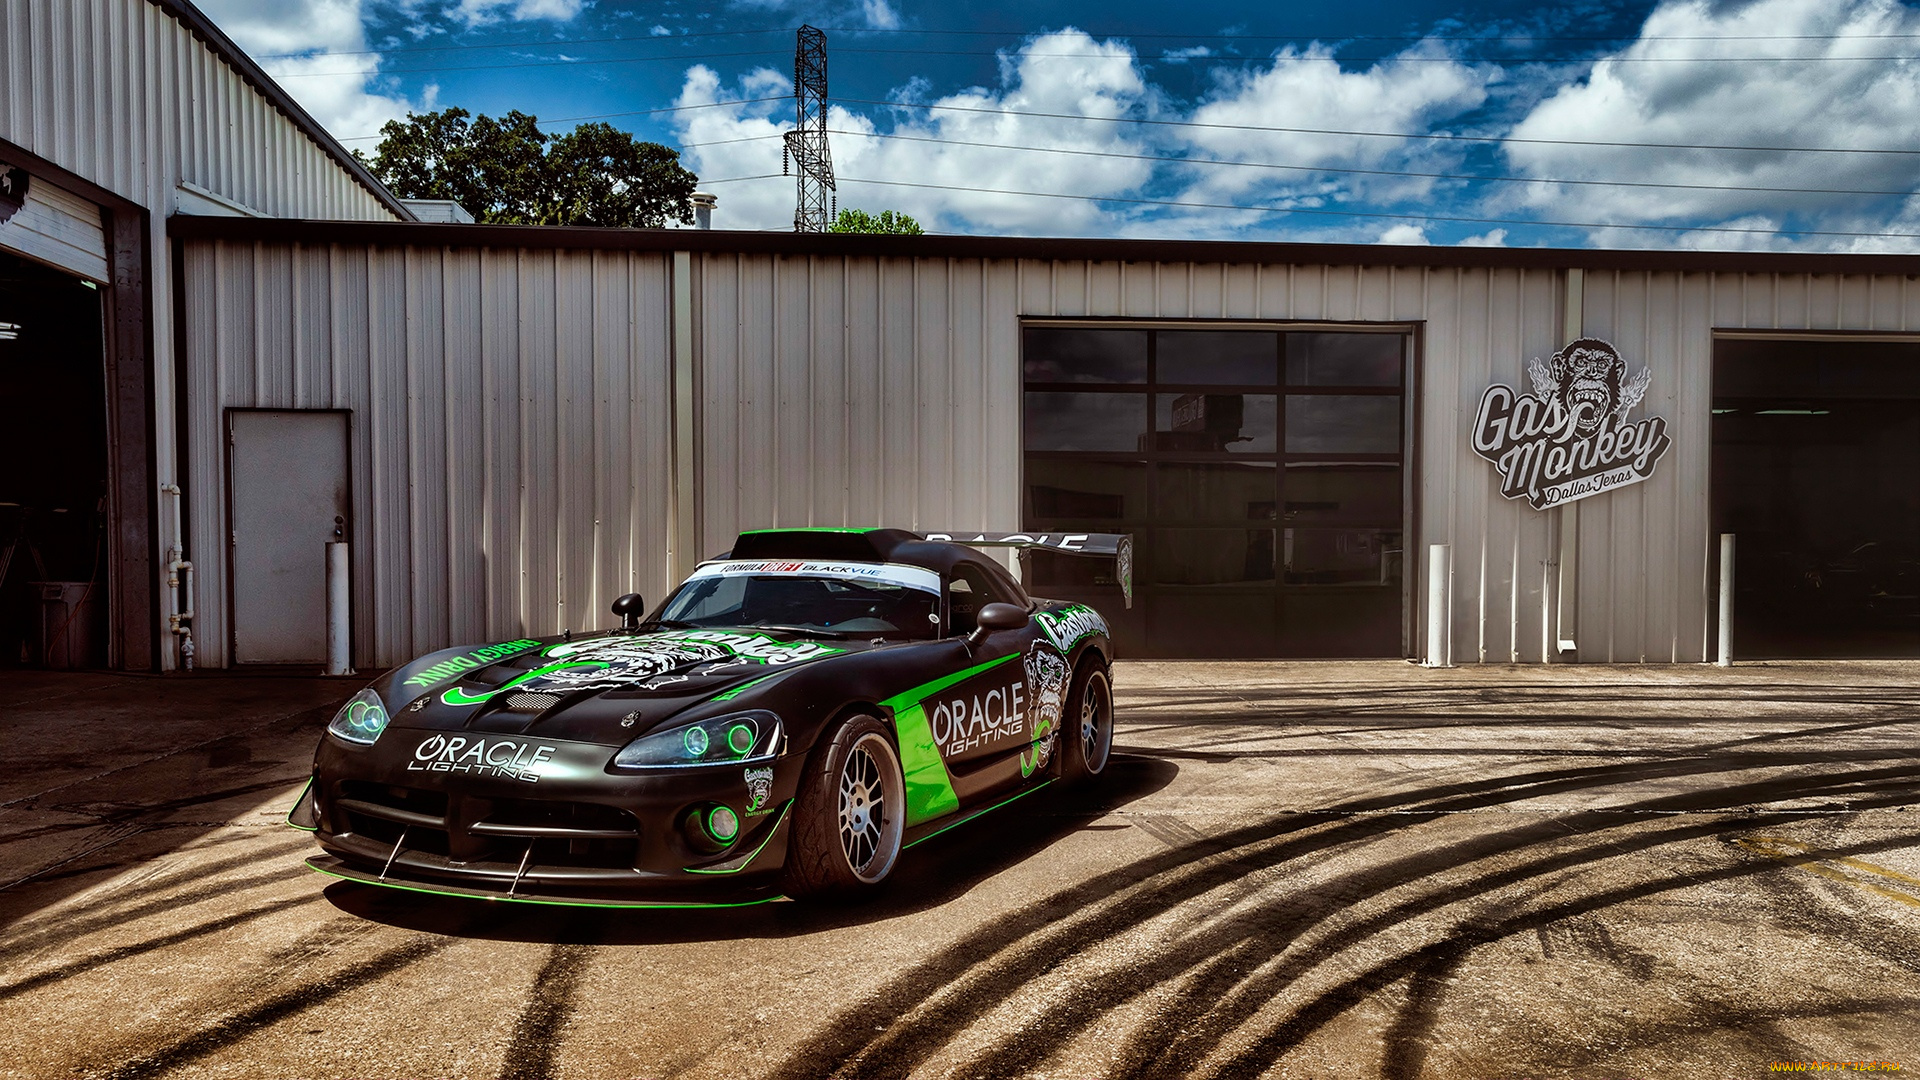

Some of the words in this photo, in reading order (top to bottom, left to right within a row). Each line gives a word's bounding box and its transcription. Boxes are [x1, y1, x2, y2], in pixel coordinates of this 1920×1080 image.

[1474, 387, 1569, 451] Gas
[1500, 413, 1664, 501] Monkey
[469, 638, 542, 663] ENERGY
[403, 656, 479, 687] DRINK
[932, 682, 1024, 746] ORACLE
[415, 734, 557, 769] ORACLE
[944, 720, 1023, 757] IGHTING
[407, 761, 541, 783] LIGHTING
